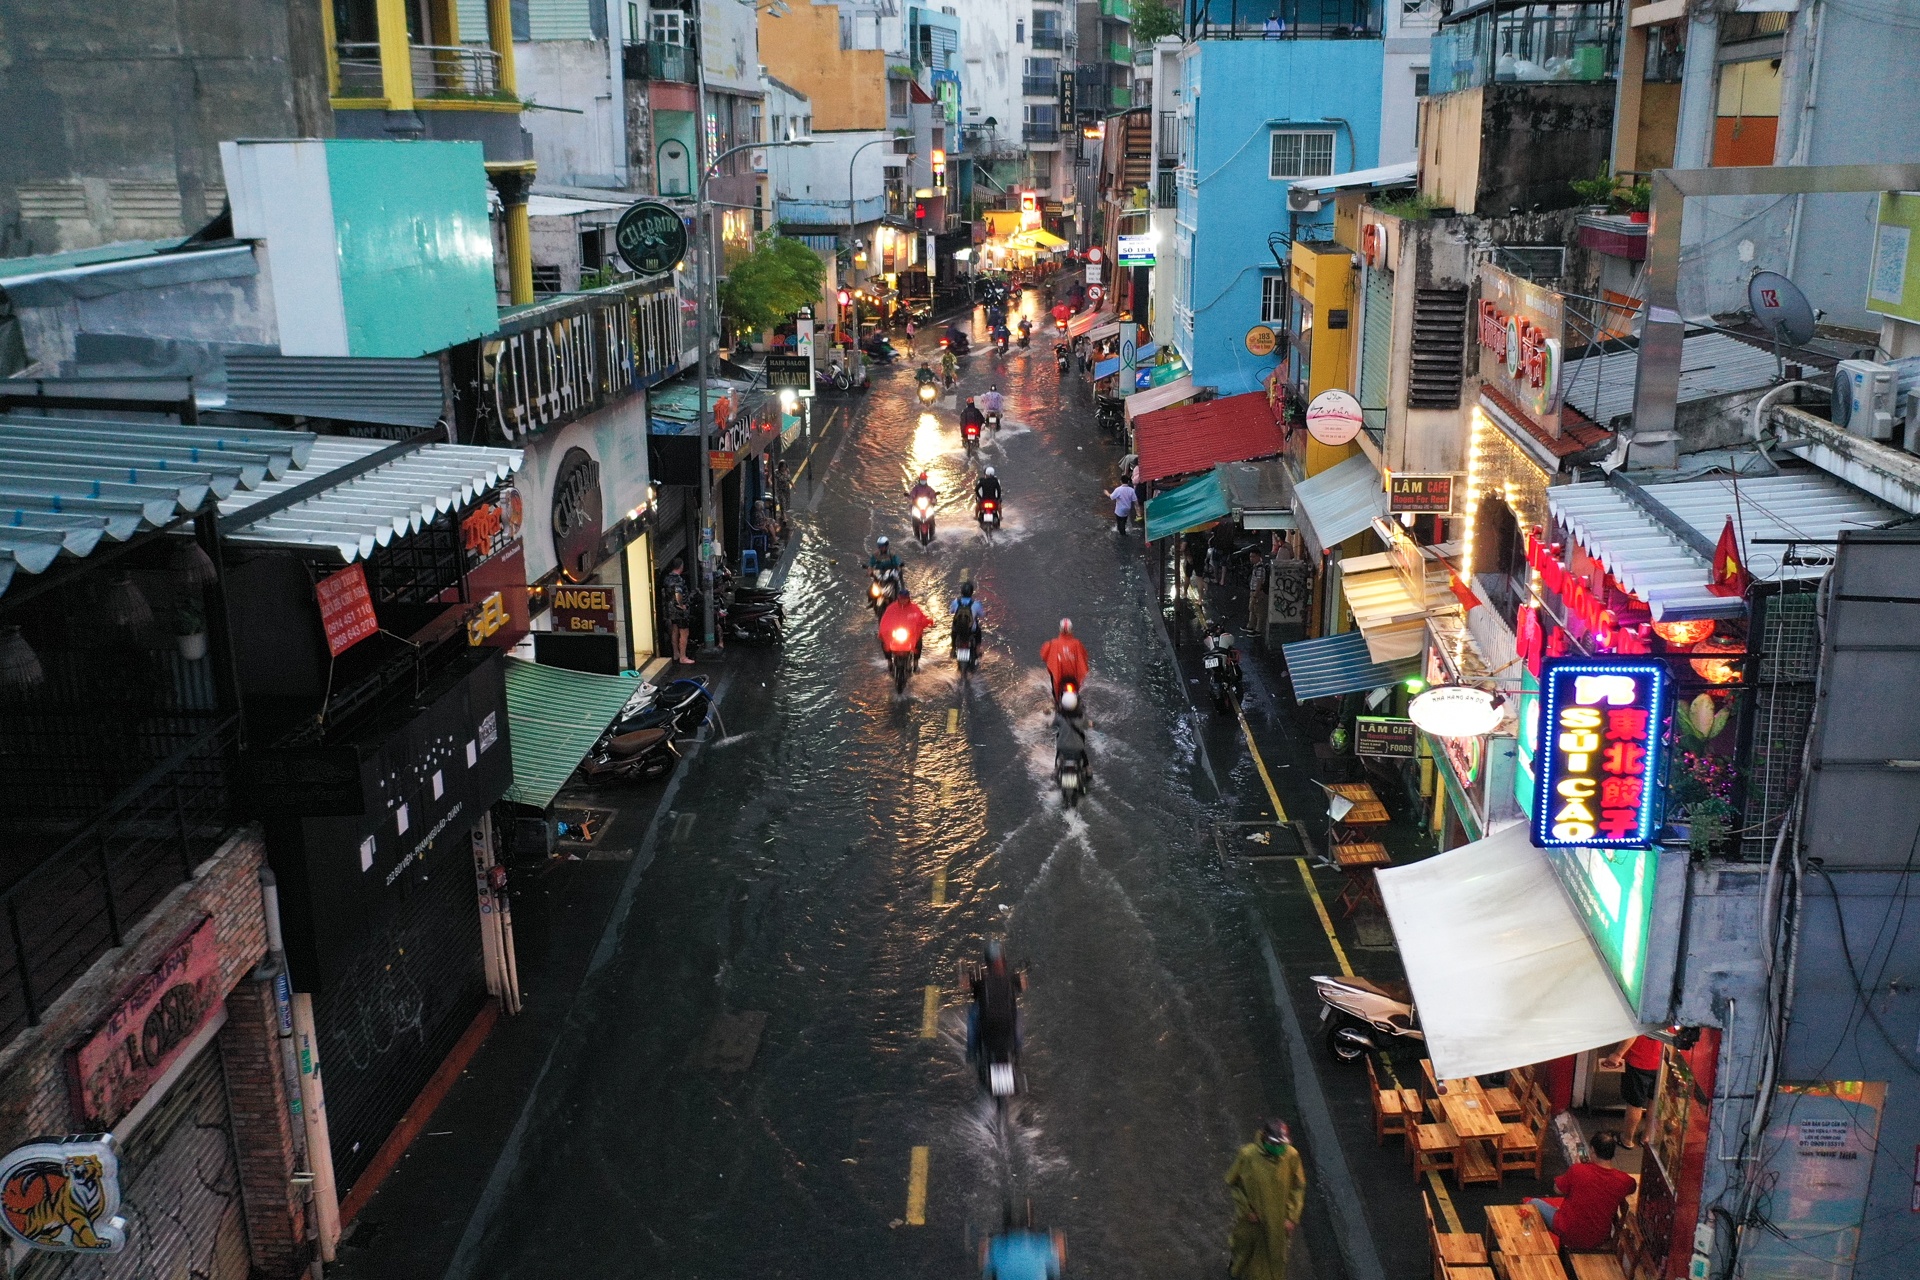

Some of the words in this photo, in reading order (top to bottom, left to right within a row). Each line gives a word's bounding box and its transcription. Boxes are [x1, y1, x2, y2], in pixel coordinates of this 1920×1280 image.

[1063, 74, 1072, 122] MERAKI
[495, 313, 594, 442] CELEBRITY
[790, 371, 808, 386] ANH
[1394, 479, 1422, 493] LÂM
[1427, 479, 1450, 493] CAFÉ
[1393, 495, 1414, 503] Room
[1416, 495, 1428, 503] For
[1430, 495, 1448, 503] Rent
[554, 590, 611, 610] ANGEL
[357, 603, 372, 618] 110
[360, 617, 376, 633] 270
[570, 616, 596, 631] Bar
[1360, 723, 1388, 733] LÂM
[1392, 726, 1413, 735] CAFÉ
[1366, 733, 1407, 741] Restaurant
[1390, 744, 1413, 752] FOODS
[1599, 707, 1649, 839] 東北餃子
